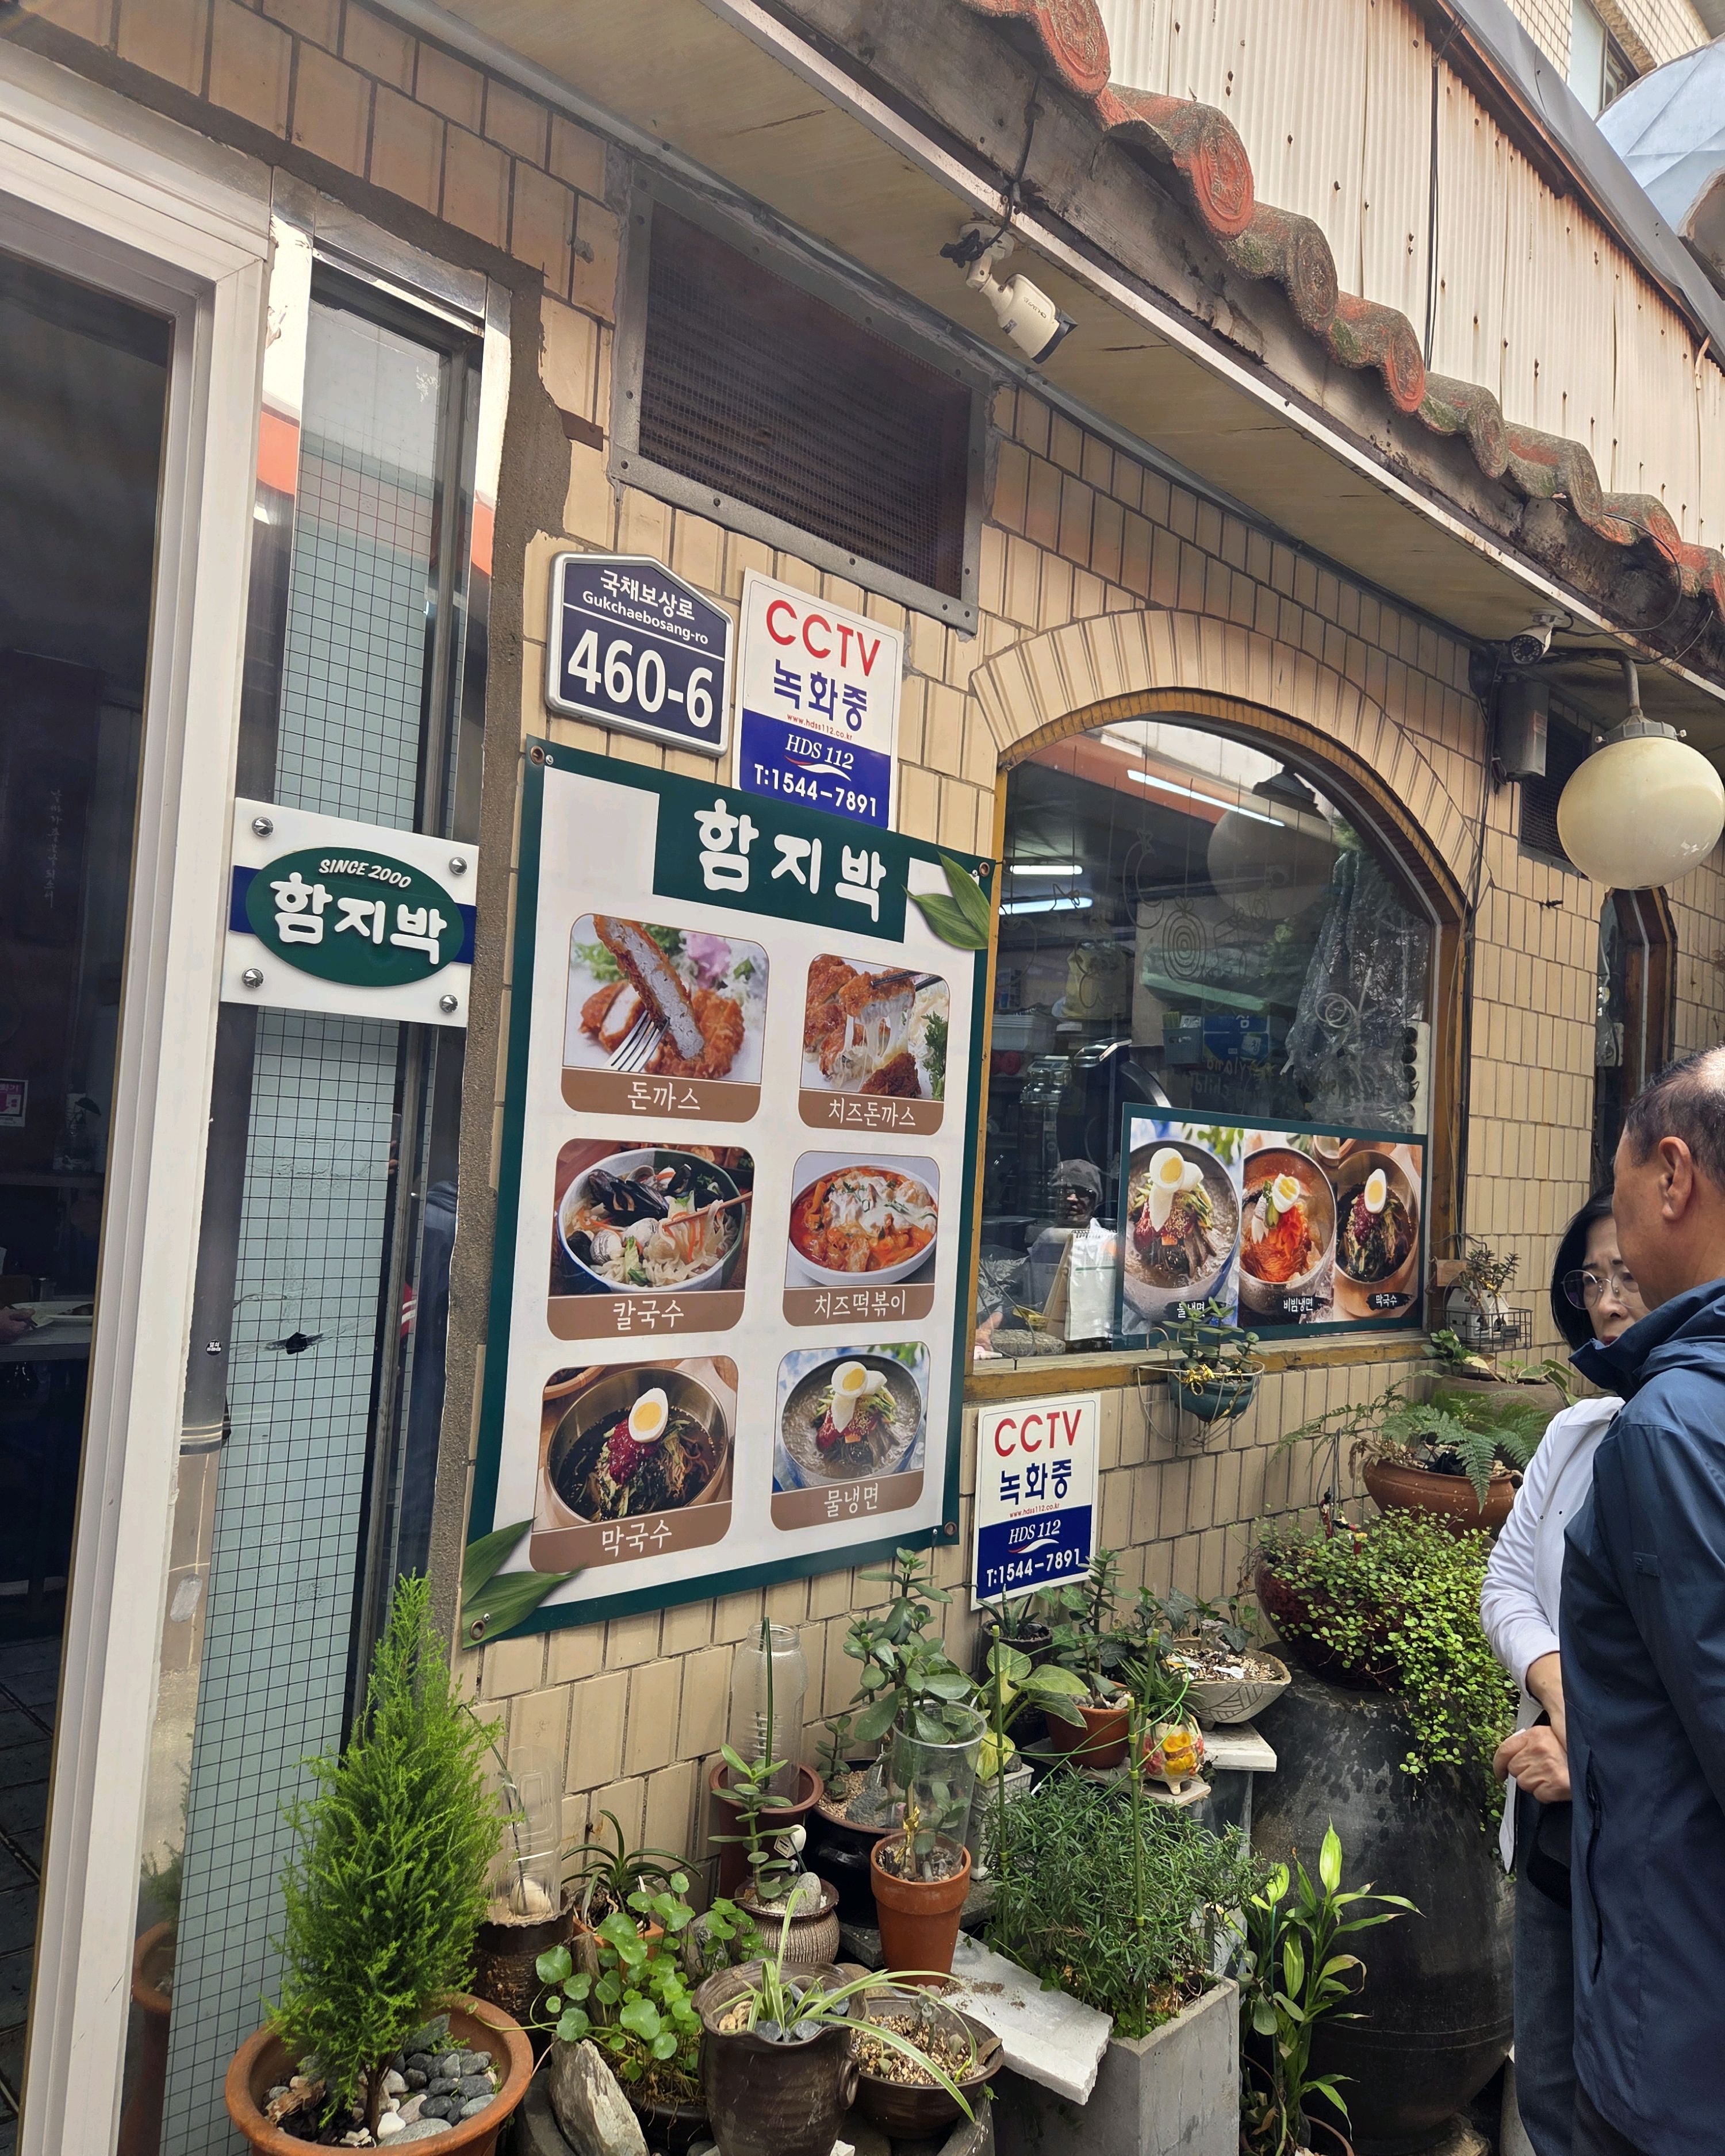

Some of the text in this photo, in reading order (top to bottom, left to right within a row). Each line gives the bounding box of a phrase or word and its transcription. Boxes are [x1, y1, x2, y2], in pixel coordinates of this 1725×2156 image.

[600, 569, 695, 620] 국채보상로
[582, 590, 708, 645] Gukchaebosang-ro
[766, 599, 881, 677] CCTV
[567, 629, 714, 728] 460-6
[773, 659, 868, 732] 녹화중
[787, 713, 853, 741] www.hdss112.co.kr
[785, 734, 855, 770] HDS 112
[754, 764, 877, 817] T:1544-7891
[319, 859, 412, 889] SINCE 2000
[694, 799, 887, 923] 함지박
[270, 872, 447, 965] 함지박
[627, 1082, 702, 1111] 돈까스
[828, 1098, 917, 1127] 치즈돈까스
[614, 1299, 684, 1331] 칼국수
[814, 1290, 906, 1319] 치즈떡볶이
[1283, 1297, 1314, 1314] 비빔냉면
[1375, 1293, 1397, 1309] 막국수
[994, 1409, 1082, 1457] CCTV
[824, 1483, 879, 1518] 물냉면
[1000, 1459, 1072, 1505] 녹화중
[1009, 1502, 1060, 1518] www.hdss112.co.kr
[602, 1519, 673, 1557] 막국수
[1009, 1519, 1061, 1544] HDS 112
[987, 1548, 1080, 1587] T:1544-7891
